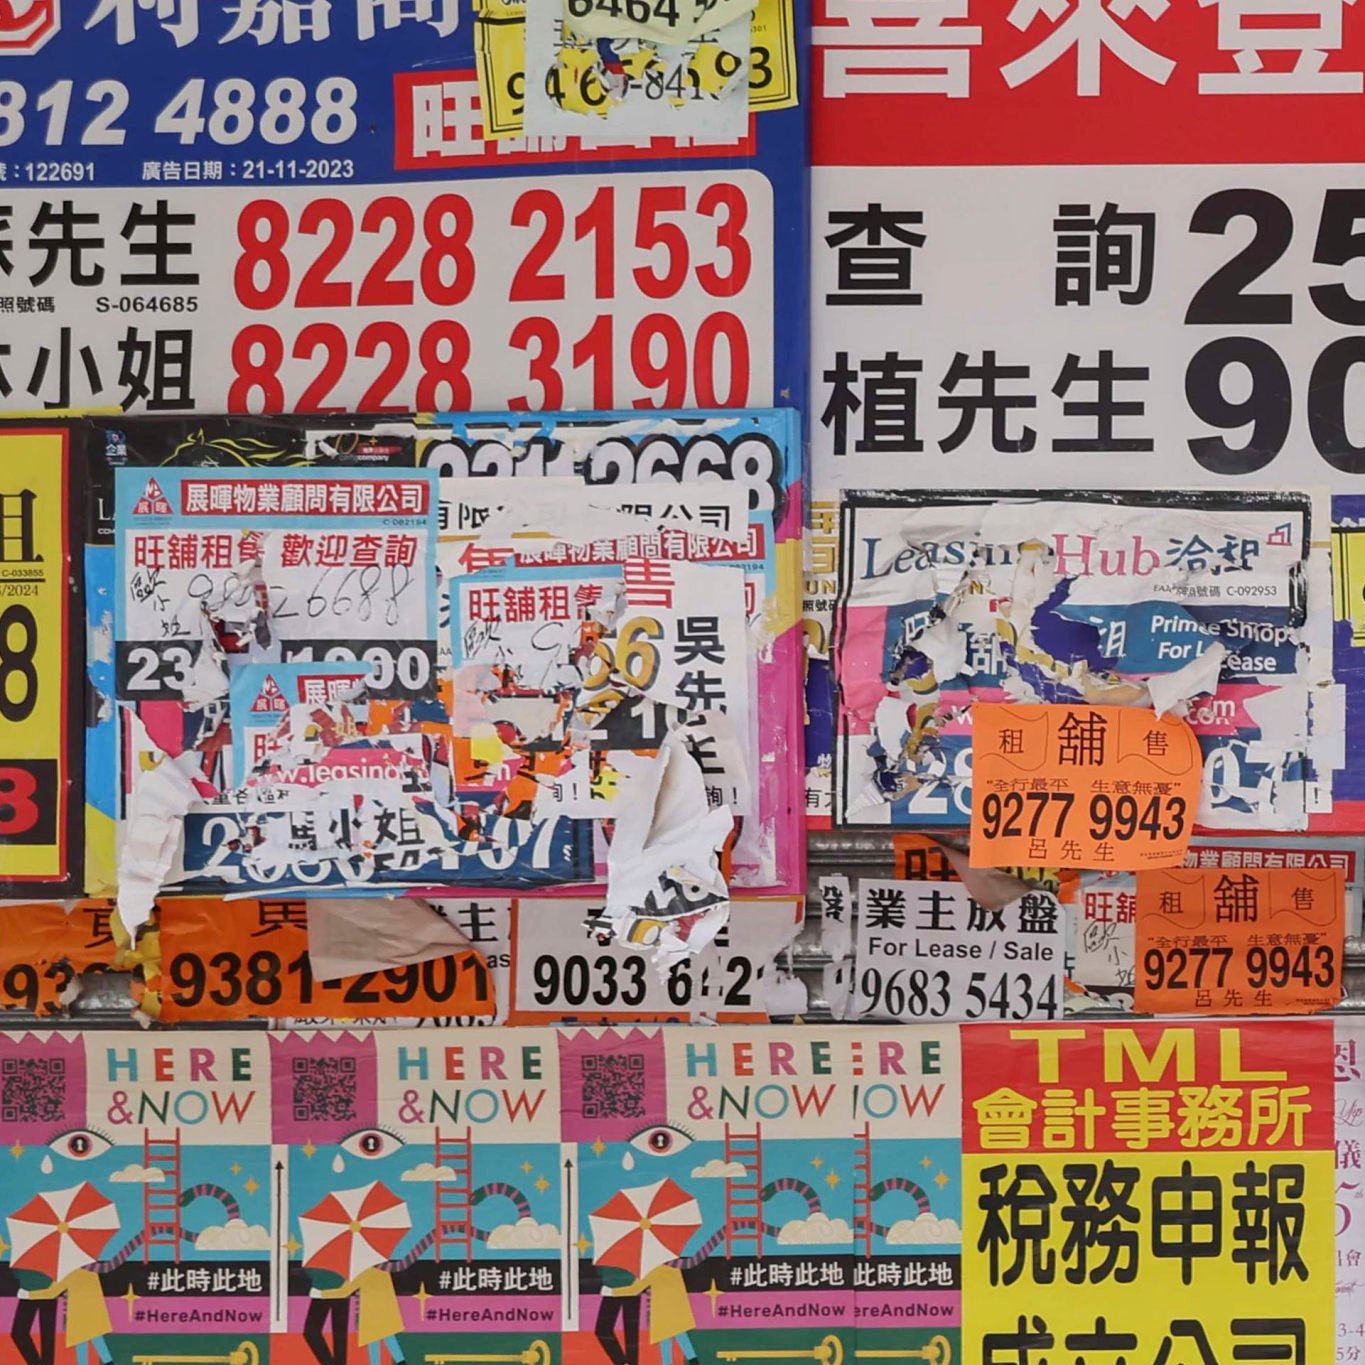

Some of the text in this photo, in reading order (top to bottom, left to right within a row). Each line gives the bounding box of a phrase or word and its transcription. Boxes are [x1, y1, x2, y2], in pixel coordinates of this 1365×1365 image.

[154, 78, 359, 145] 4888
[233, 184, 753, 312] 8228 2153
[95, 294, 199, 315] S-064685
[820, 350, 1155, 456] 植先生
[281, 533, 419, 568] 歡迎查詢
[1052, 533, 1161, 577] Hub
[999, 712, 1168, 766] 租 舖 售
[982, 793, 1185, 840] 9277 9943
[1029, 840, 1115, 862] 呂先生
[535, 954, 648, 1005] 9033
[861, 968, 1058, 1020] 9683 5434
[107, 1047, 252, 1081] HERE
[1009, 1028, 1288, 1083] TML
[107, 1089, 256, 1125] &NOW
[972, 1086, 1312, 1149] 會計事務所
[147, 1268, 263, 1292] #此時此地
[134, 1309, 263, 1324] #HereAndNow
